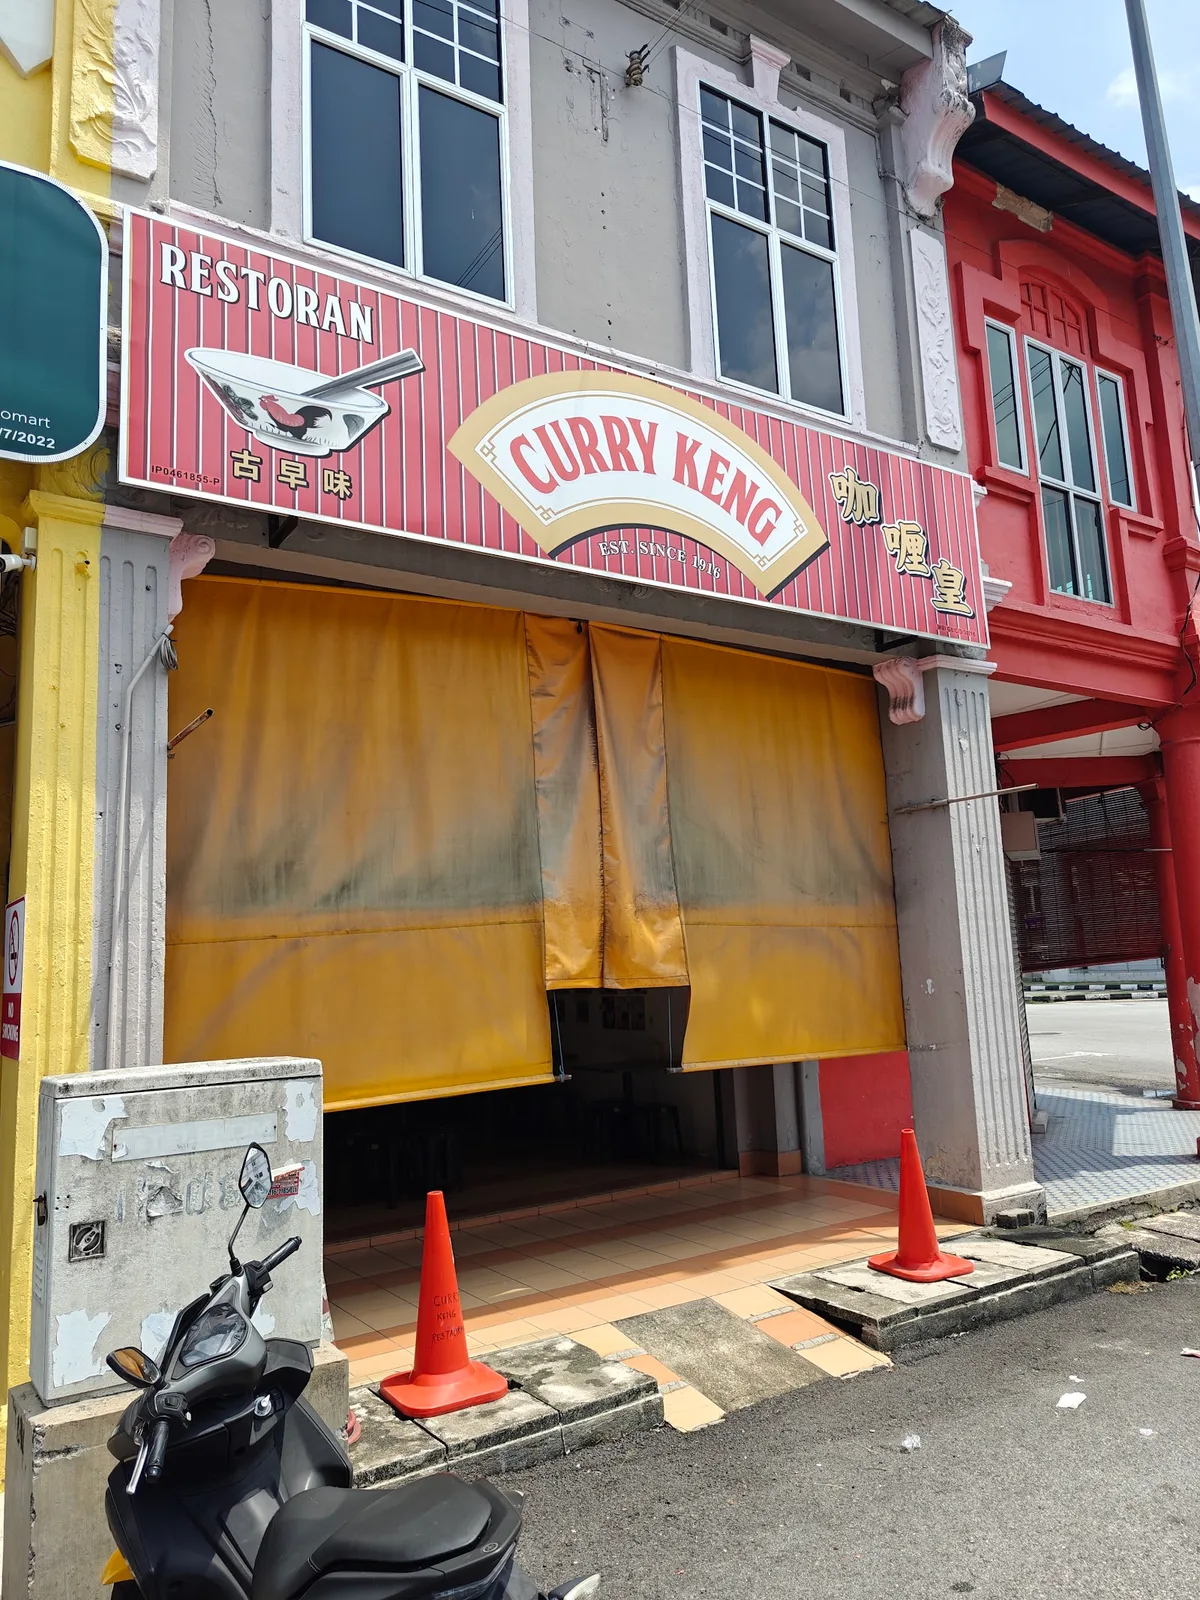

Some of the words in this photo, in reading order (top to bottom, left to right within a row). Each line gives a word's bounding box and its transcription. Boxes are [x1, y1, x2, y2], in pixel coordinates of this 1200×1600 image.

[160, 241, 374, 345] RESTORAN
[151, 464, 220, 485] IP0461855-P
[230, 448, 353, 500] 古早味
[509, 415, 659, 494] CURRY
[672, 431, 783, 547] KENG
[598, 540, 635, 556] EST.
[639, 541, 687, 563] SINCE
[691, 555, 721, 579] 1916
[829, 466, 975, 618] 咖喱皇
[436, 1309, 456, 1320] KENG
